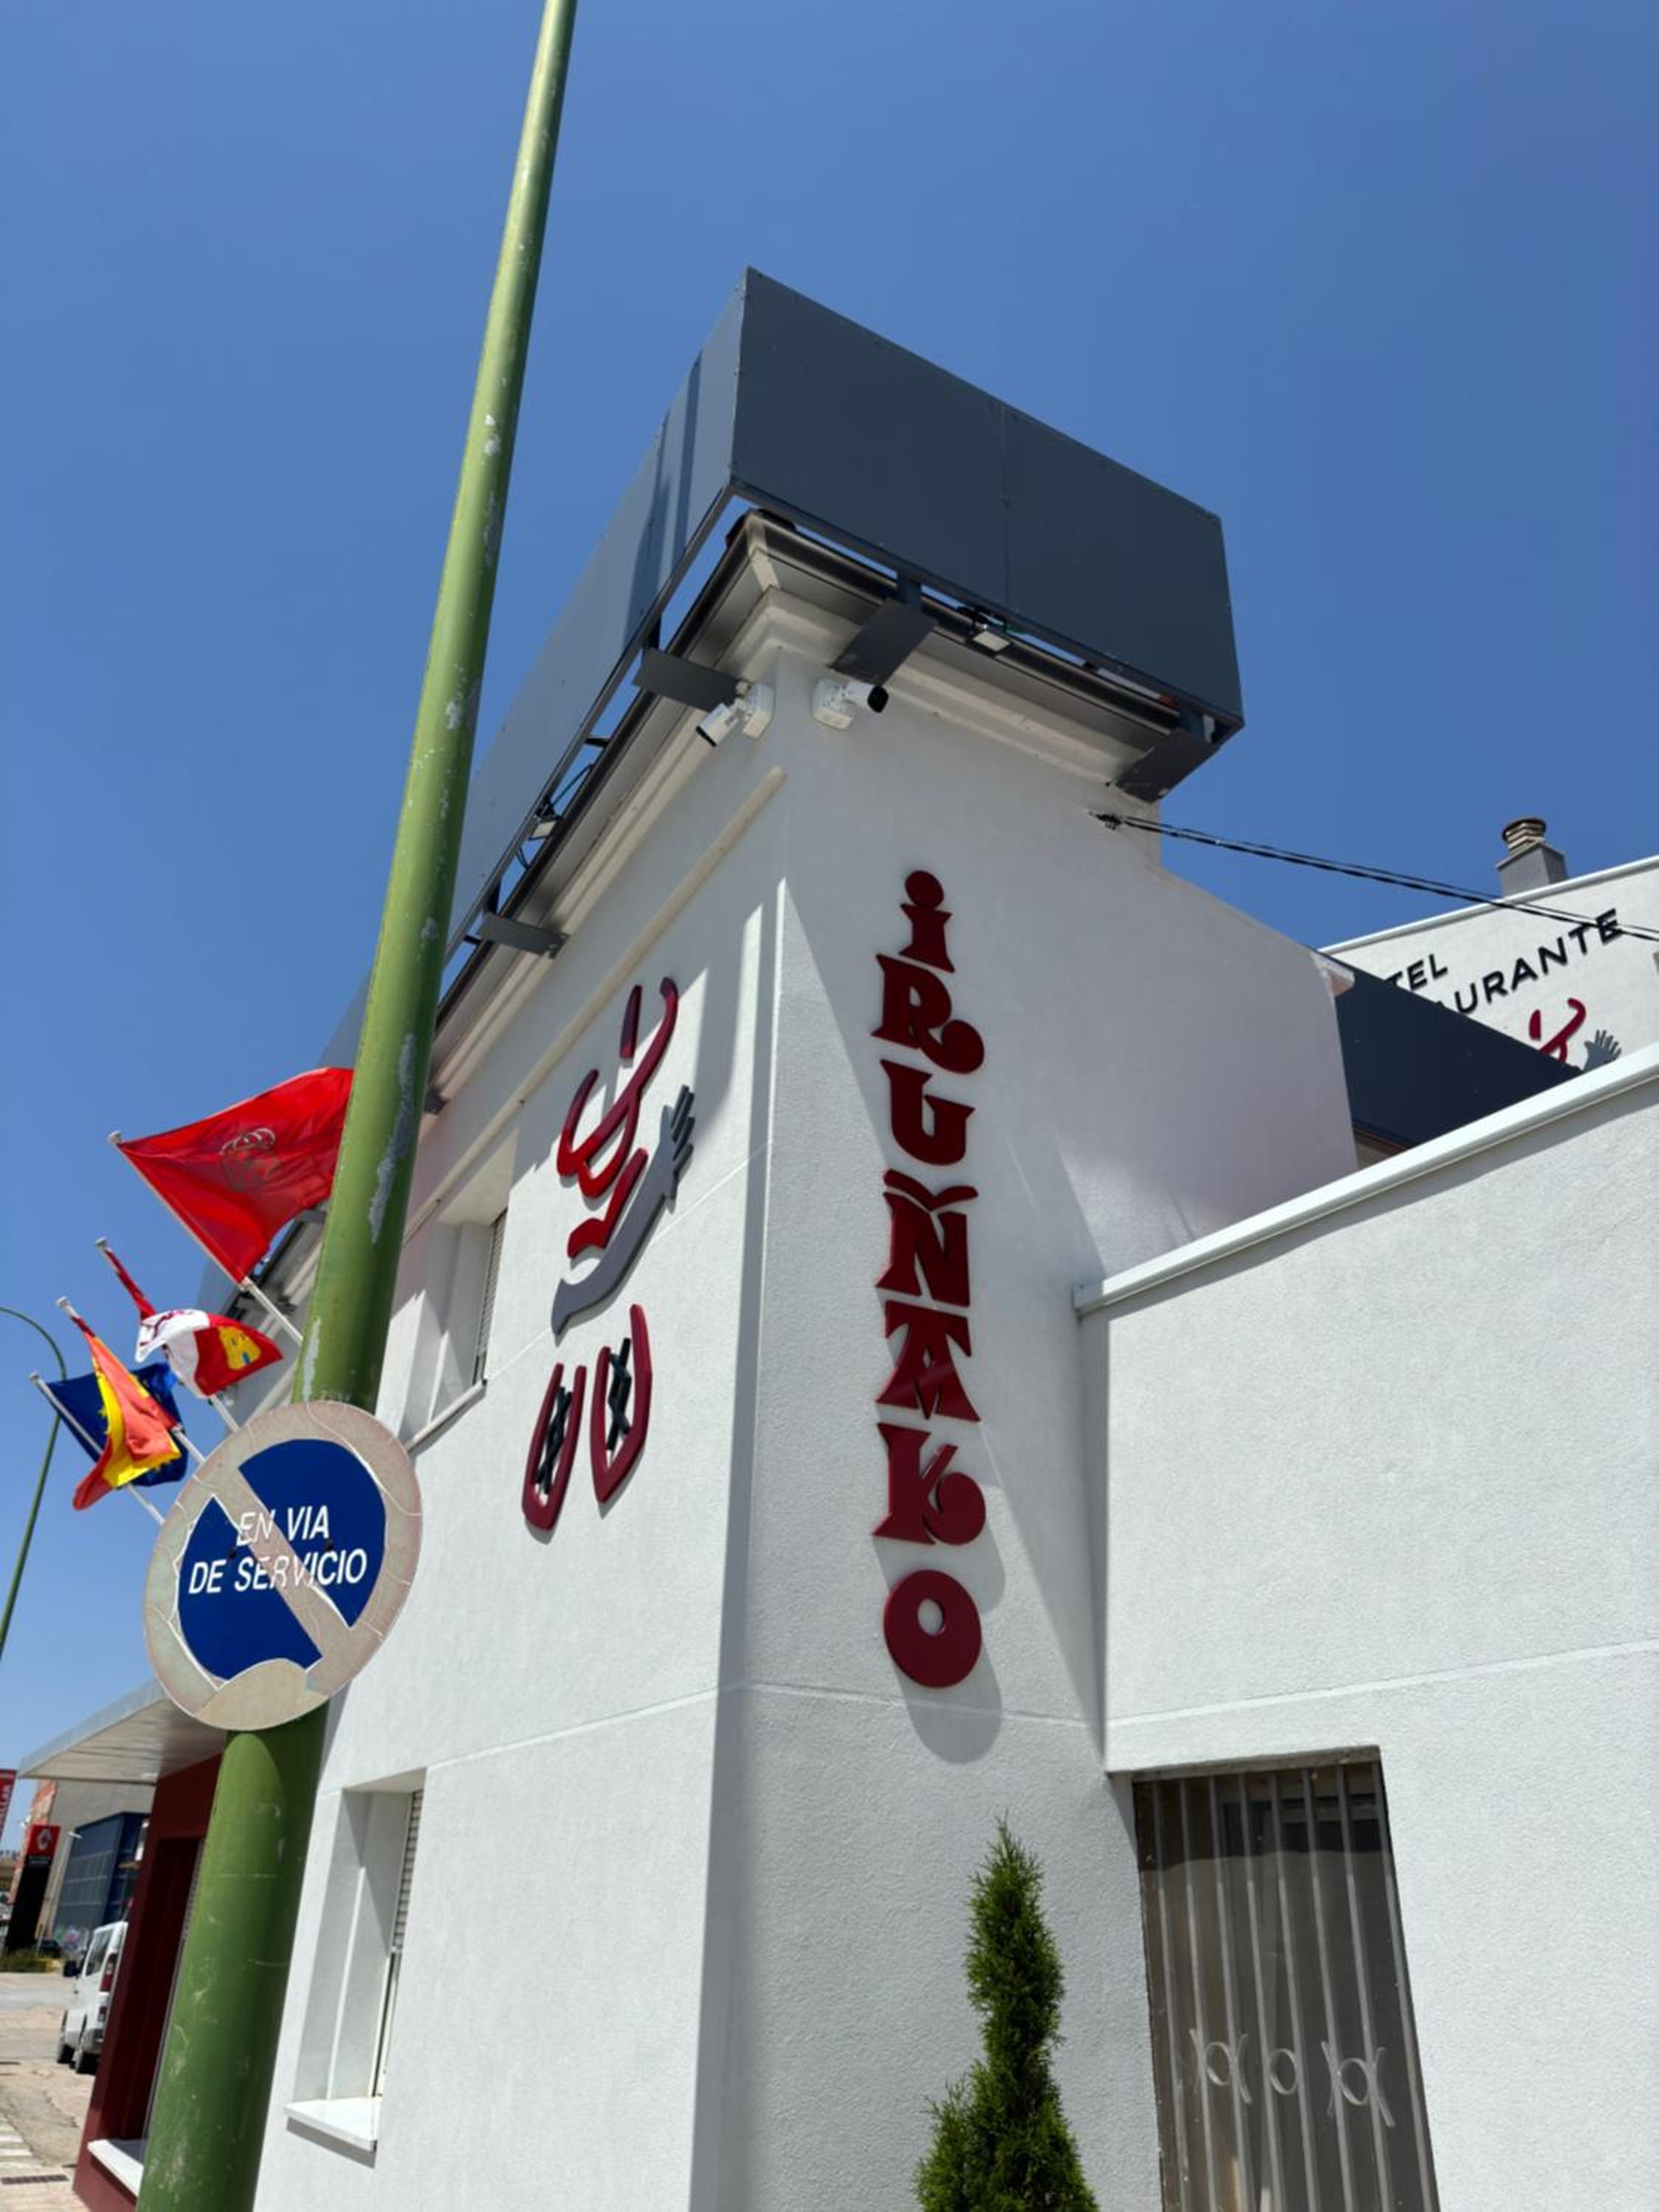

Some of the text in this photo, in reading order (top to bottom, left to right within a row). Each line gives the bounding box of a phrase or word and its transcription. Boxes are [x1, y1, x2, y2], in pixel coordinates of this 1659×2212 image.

[1436, 908, 1622, 1014] URANTE
[236, 1504, 330, 1546] EN VIA
[189, 1548, 368, 1594] DE SERVICIO
